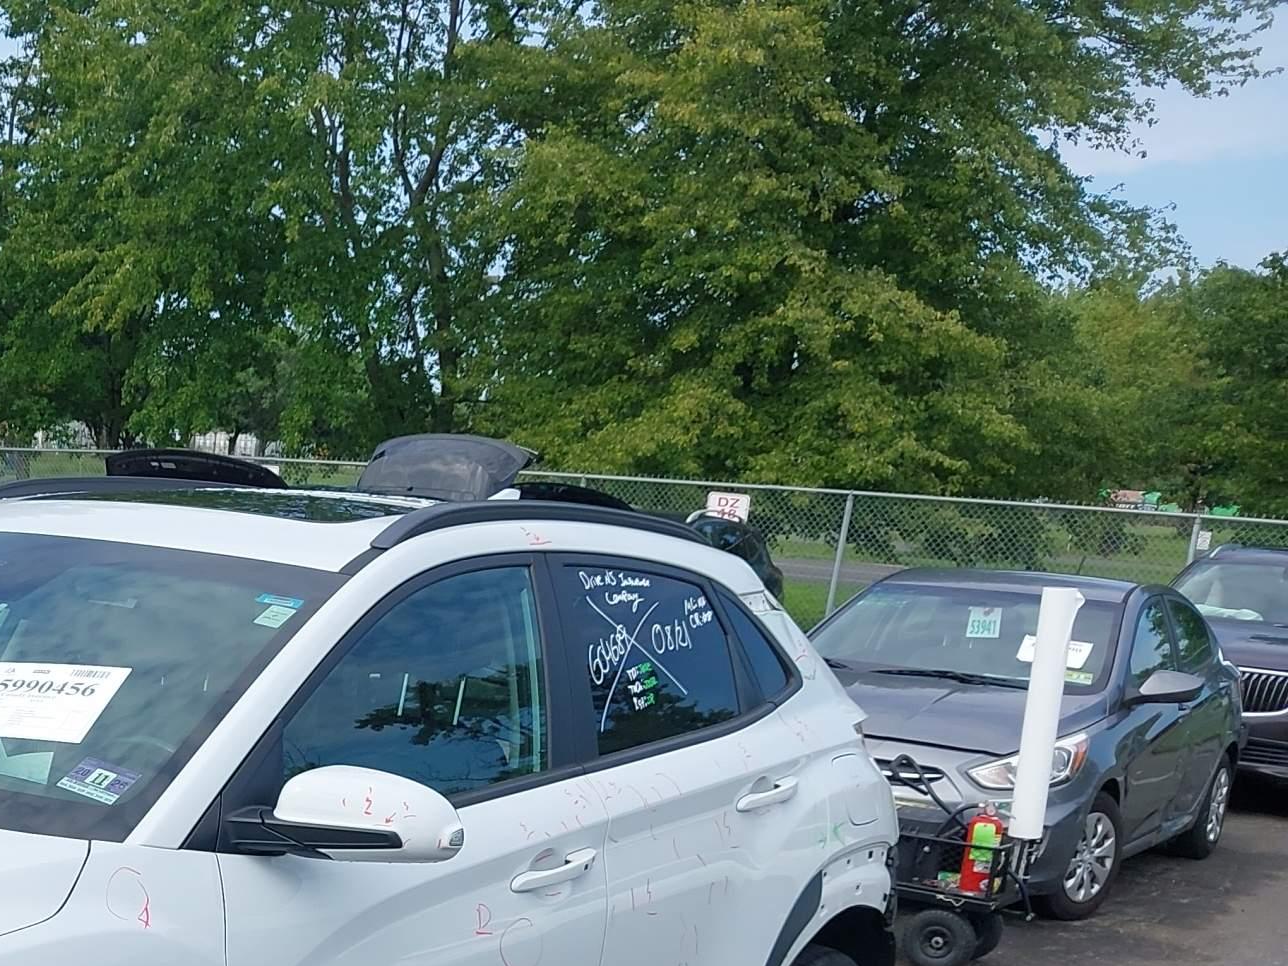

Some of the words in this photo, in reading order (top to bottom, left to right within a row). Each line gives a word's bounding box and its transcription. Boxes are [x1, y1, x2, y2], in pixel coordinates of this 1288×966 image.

[718, 497, 740, 507] DZ
[968, 619, 998, 635] 53941
[90, 772, 110, 786] 11
